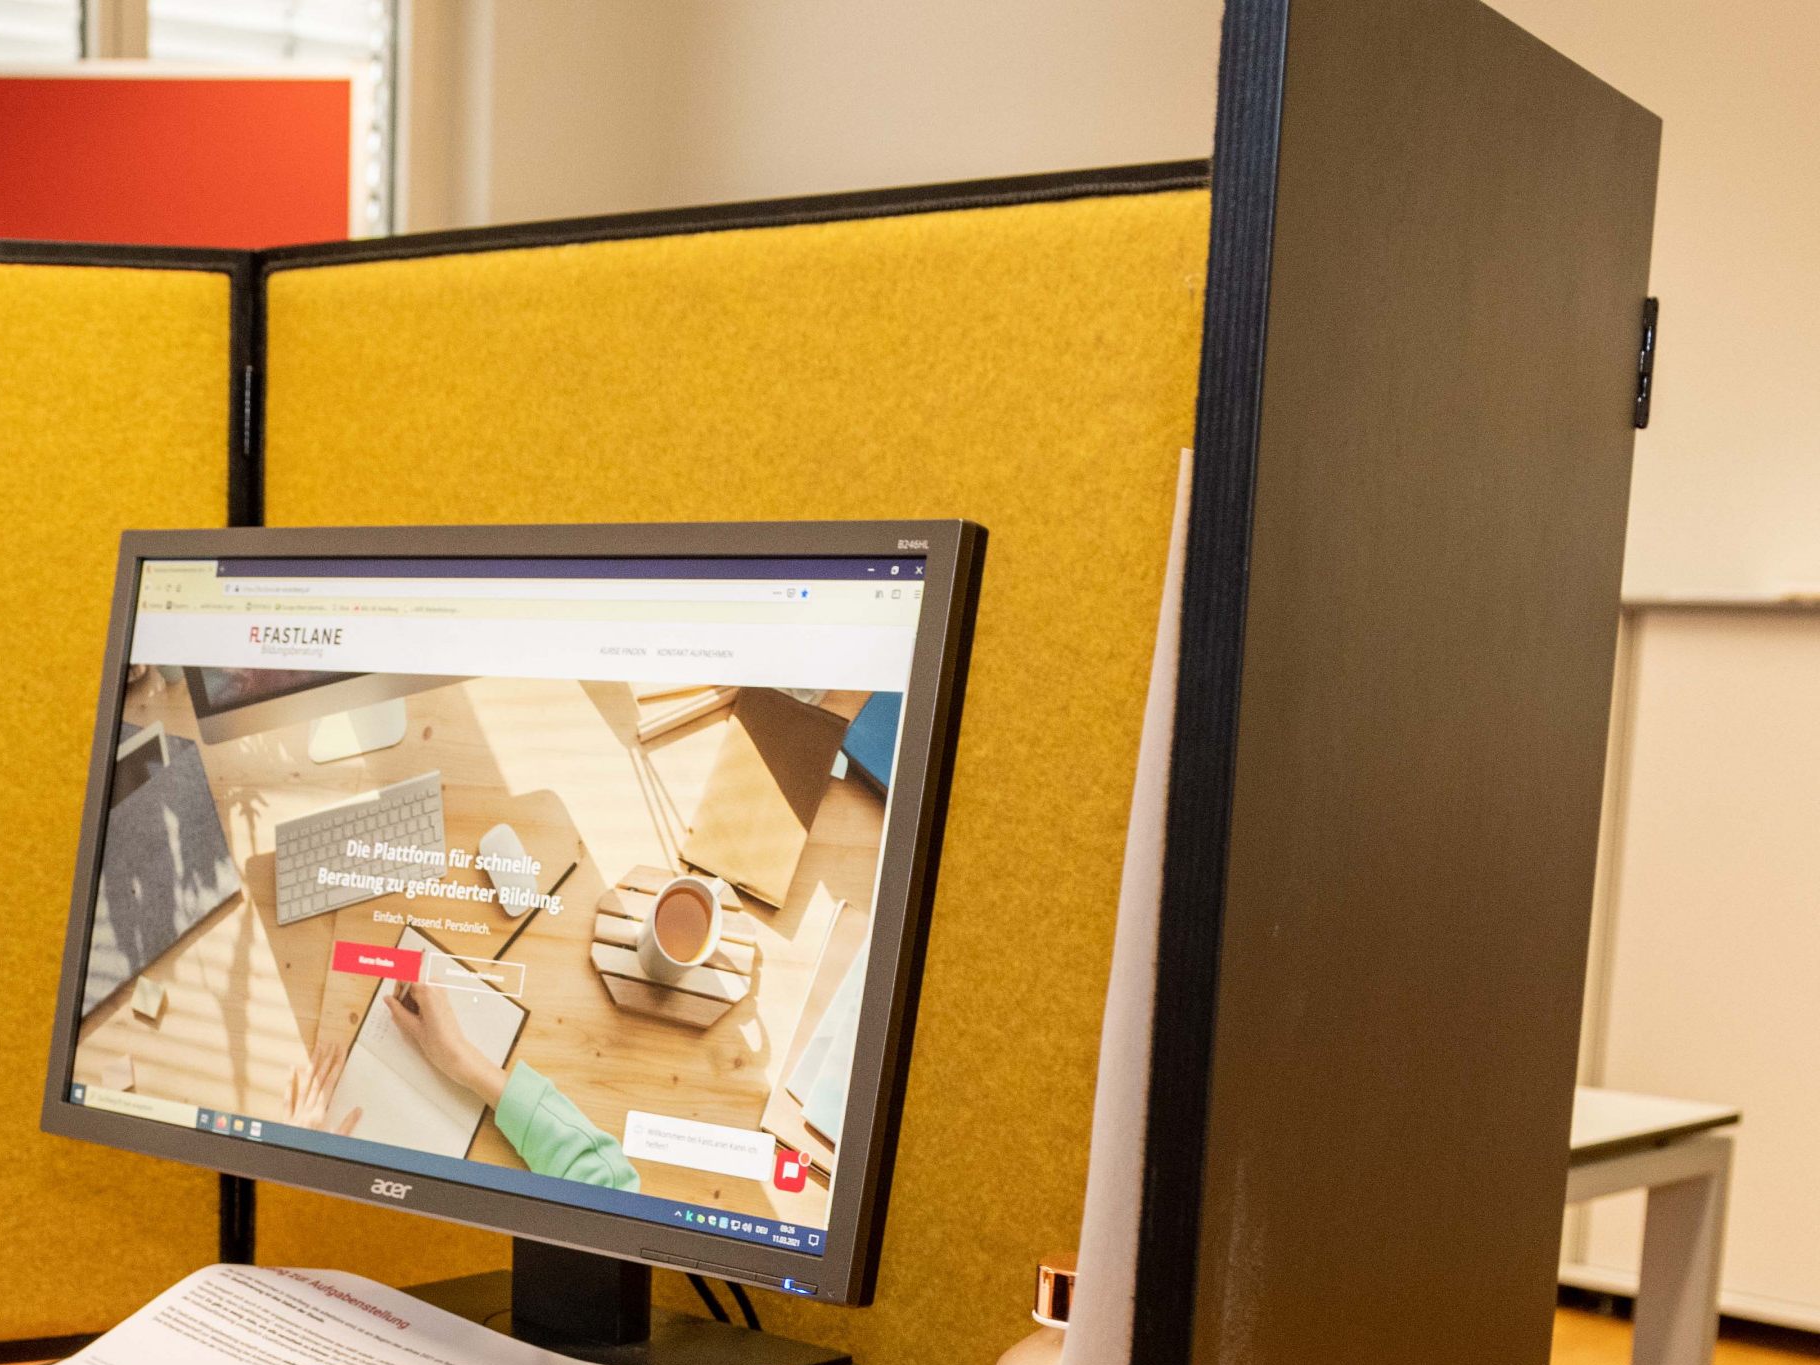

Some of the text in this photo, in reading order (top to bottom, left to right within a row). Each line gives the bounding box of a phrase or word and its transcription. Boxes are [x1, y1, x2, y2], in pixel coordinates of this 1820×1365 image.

[262, 627, 343, 645] FASTLANE
[346, 840, 541, 875] Die Plattform für schnelle
[317, 867, 565, 916] Beratung zu geförderter Bildung.
[372, 911, 491, 936] Einfach. Passend. Persönlich.
[371, 1179, 412, 1200] acer
[309, 1279, 411, 1331] Aufgabenstellung
